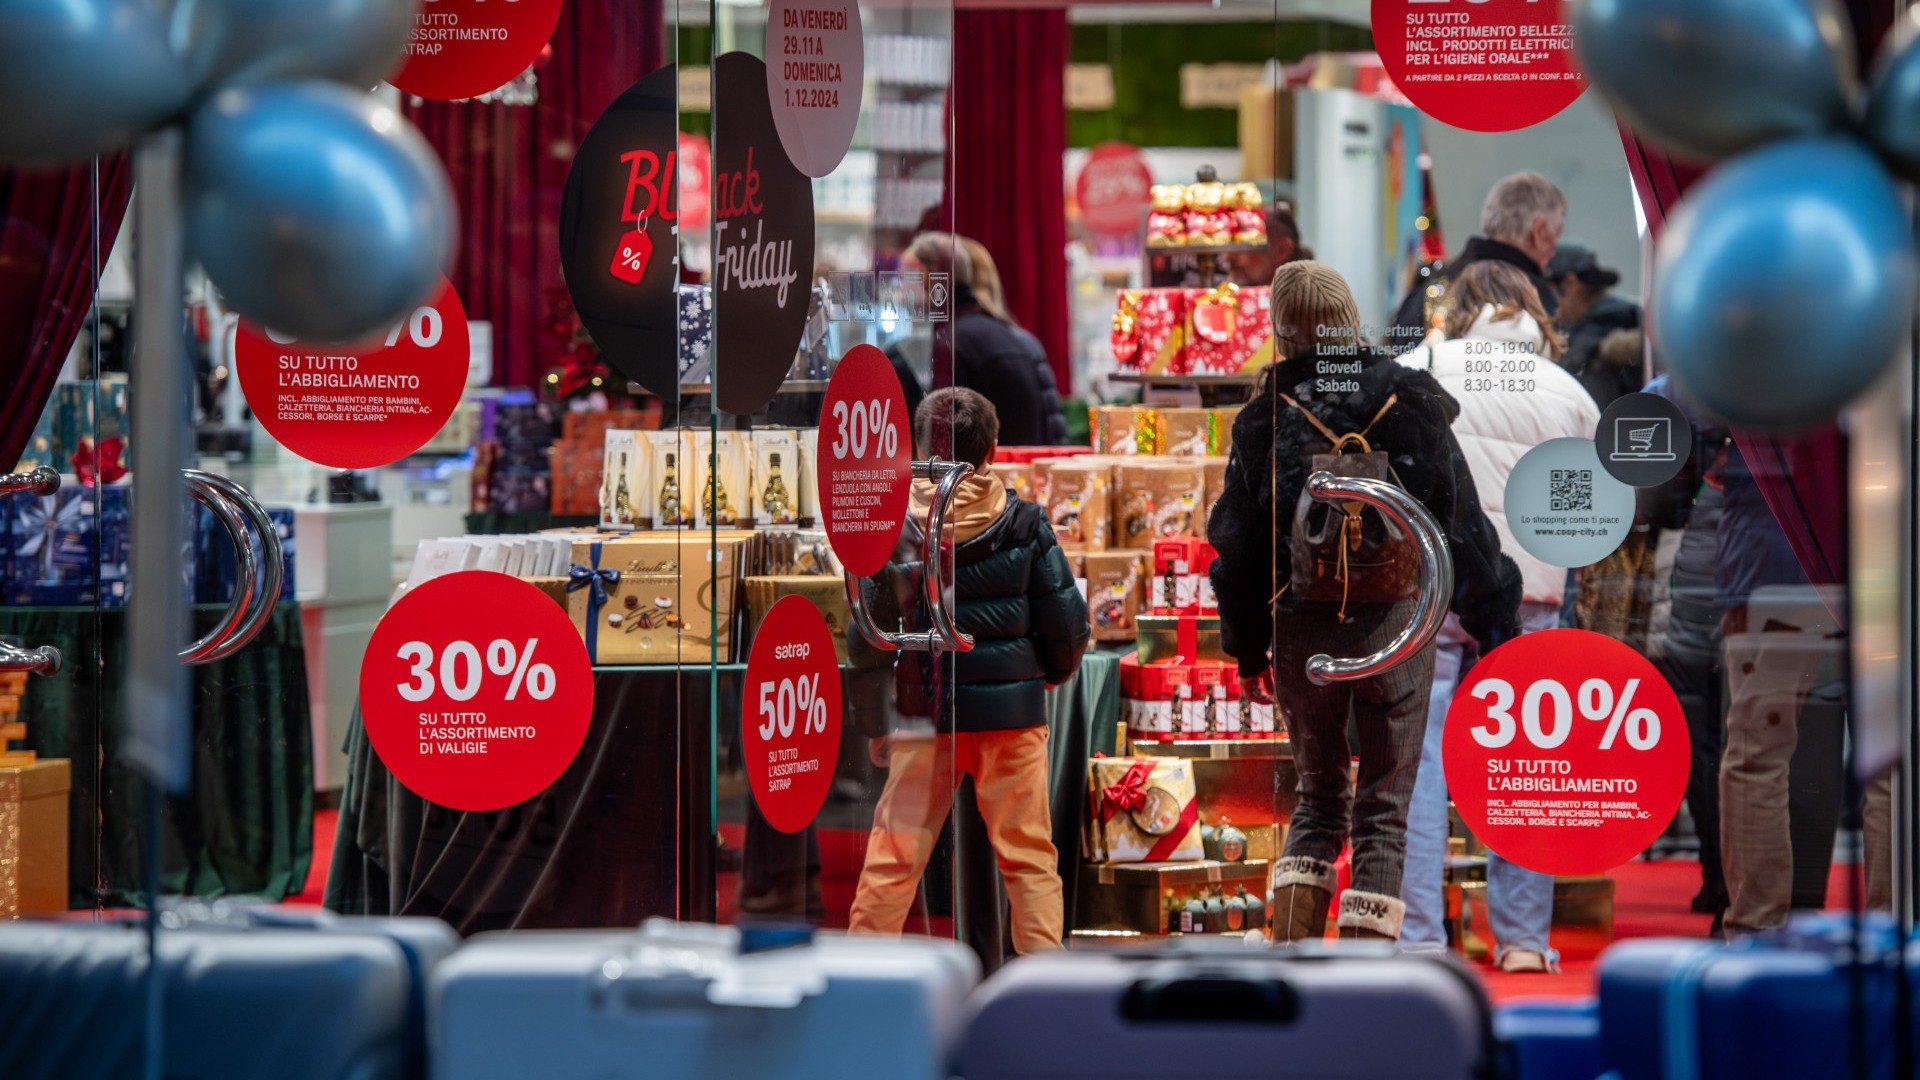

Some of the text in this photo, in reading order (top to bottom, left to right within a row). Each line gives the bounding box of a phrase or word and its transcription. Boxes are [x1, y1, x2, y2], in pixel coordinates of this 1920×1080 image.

[415, 14, 458, 26] TUTTO
[784, 7, 847, 30] DA VENERDÌ
[1406, 12, 1470, 24] SU TUTTO
[408, 28, 508, 40] SSORTIMENTO
[1406, 25, 1576, 38] L'ASSORTIMENTO BELLEZZ
[400, 44, 442, 55] ATRAP
[784, 35, 823, 55] 29.11 A
[1406, 38, 1574, 52] INCL. PRODOTTI ELETTRICI
[1406, 53, 1430, 65] PER
[1434, 52, 1486, 65] L'IGIENE
[784, 62, 842, 82] DOMENICA
[1406, 74, 1412, 82] A
[1412, 74, 1443, 82] PARTIRE
[1444, 74, 1455, 82] DA
[1456, 74, 1462, 82] 2
[1539, 72, 1561, 80] CONF.
[1563, 72, 1574, 80] DA
[784, 88, 838, 108] 1.12.2024
[716, 218, 798, 308] Friday
[1316, 324, 1354, 337] Orario
[1316, 342, 1358, 356] Lunedì
[1370, 342, 1415, 356] venerdì
[278, 356, 358, 370] SU TUTTO
[1316, 360, 1362, 374] Giovedì
[279, 373, 420, 389] L'ABBIGLIAMENTO
[1316, 379, 1360, 392] Sabato
[301, 396, 366, 404] ABBIGLIAMENTO
[368, 396, 384, 404] PER
[386, 397, 422, 406] BAMBINI,
[278, 404, 432, 414] CALZETTERIA, BIANCHERIA INTIMA, AC-
[278, 412, 314, 421] CESSORI,
[317, 413, 344, 421] BORSE
[832, 399, 898, 460] 30%
[832, 469, 897, 481] SU BIANCHERIA DA LETTO,
[832, 483, 892, 494] LENZUOLA CON ANGOLI,
[832, 496, 882, 507] PIUMONI E CUSCINI,
[832, 508, 869, 520] MOLLETTONI E
[1521, 516, 1530, 524] Lo
[1532, 516, 1567, 525] shopping
[1591, 516, 1597, 524] ti
[1600, 516, 1620, 525] piace
[832, 522, 862, 532] BIANCHERIA
[864, 522, 870, 532] IN
[1535, 528, 1608, 537] www.coop-city.ch
[775, 642, 810, 660] satrap
[396, 638, 556, 702] 30%
[759, 672, 826, 740] 50%
[419, 712, 486, 724] SU TUTTO
[1470, 678, 1661, 750] 30%
[420, 726, 536, 740] L'ASSORTIMENTO
[420, 742, 488, 754] DI VALIGIE
[768, 748, 798, 762] SU TUTTO
[768, 759, 818, 778] L'ASSORTIMENTO
[1487, 760, 1571, 774] SU TUTTO
[768, 778, 792, 792] SATRAP
[1488, 777, 1638, 794] L'ABBIGLIAMENTO
[1487, 800, 1640, 811] INCL. ABBIGLIAMENTO PER BAMBINI,
[1487, 809, 1547, 818] CALZETTERIA,
[1549, 810, 1600, 818] BIANCHERIA
[1602, 811, 1635, 820] INTIMA,
[1487, 818, 1526, 826] CESSORI,
[1528, 818, 1557, 826] BORSE
